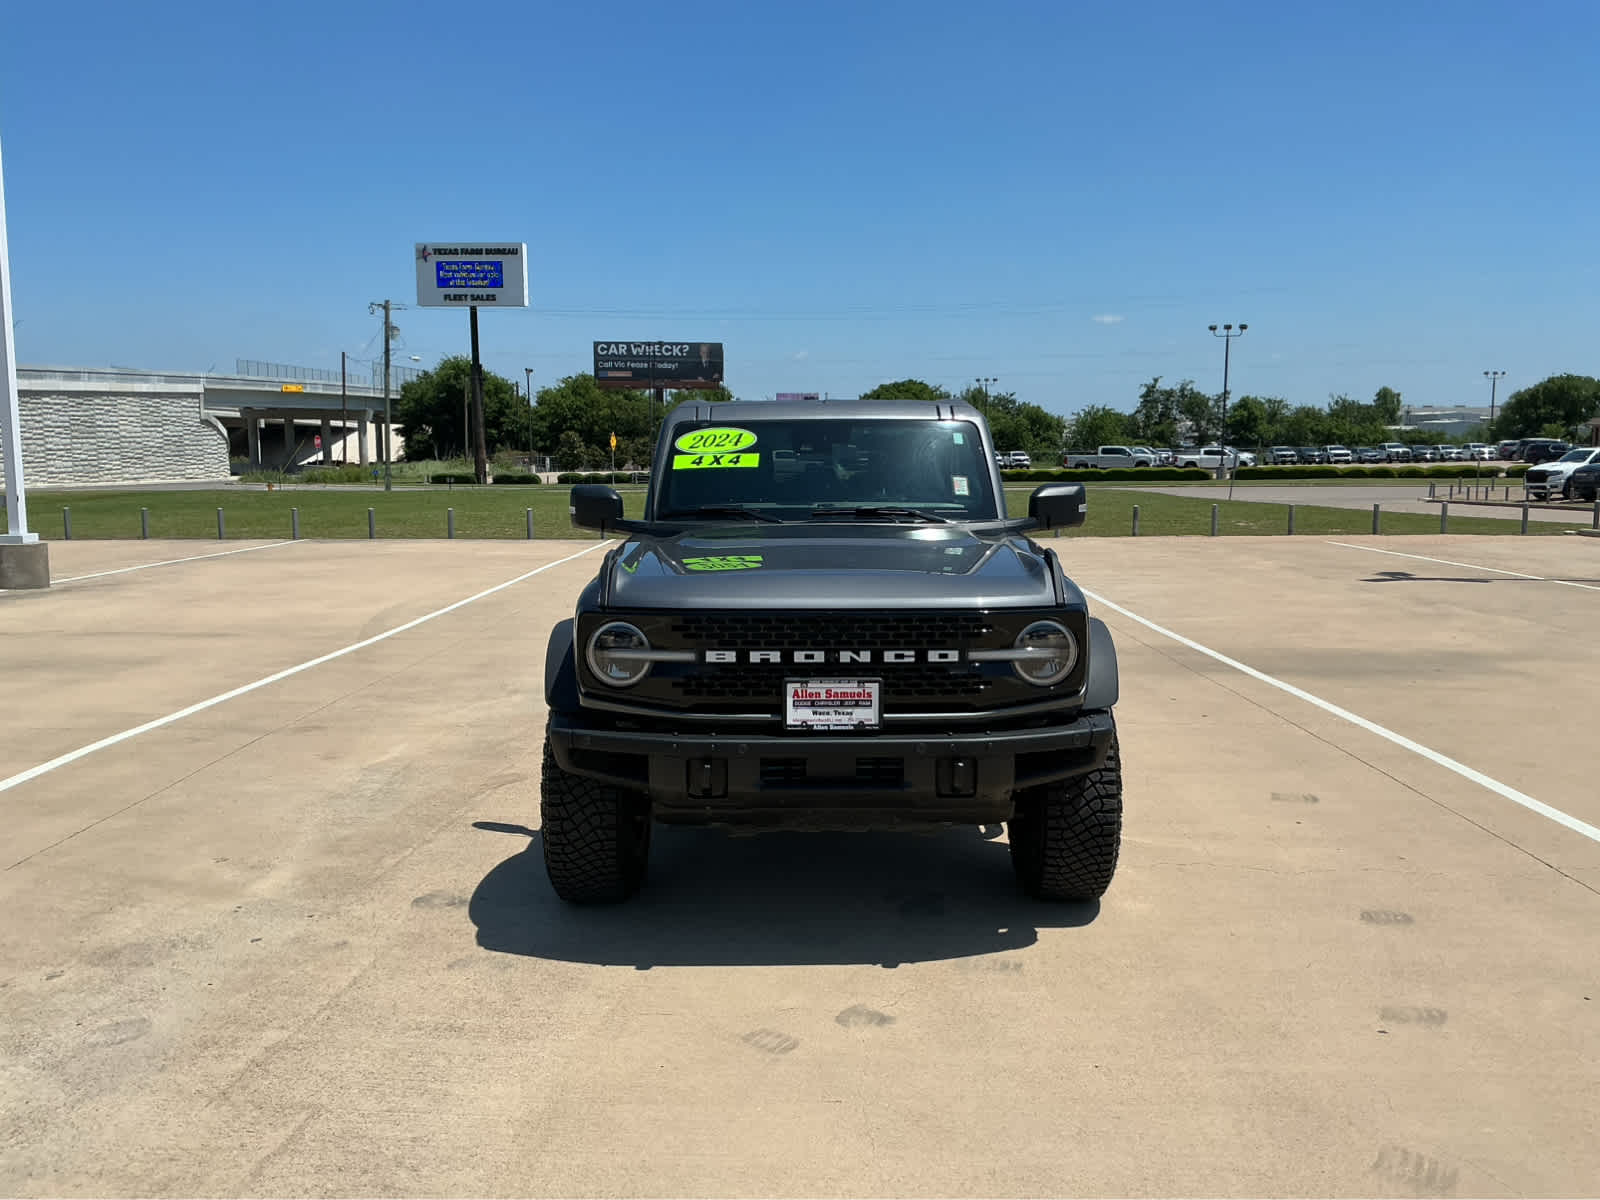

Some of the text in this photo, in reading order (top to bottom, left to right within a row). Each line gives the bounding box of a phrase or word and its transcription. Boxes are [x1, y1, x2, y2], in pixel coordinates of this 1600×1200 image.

[432, 247, 519, 256] TEXAS FARM BUREAU
[443, 293, 497, 302] FLEET SALES
[597, 343, 690, 357] CAR WRECK?
[598, 361, 613, 369] Call
[614, 361, 625, 369] Vic
[687, 432, 744, 450] 2024
[705, 650, 960, 663] BRONCO
[792, 688, 873, 699] Allen Samuels
